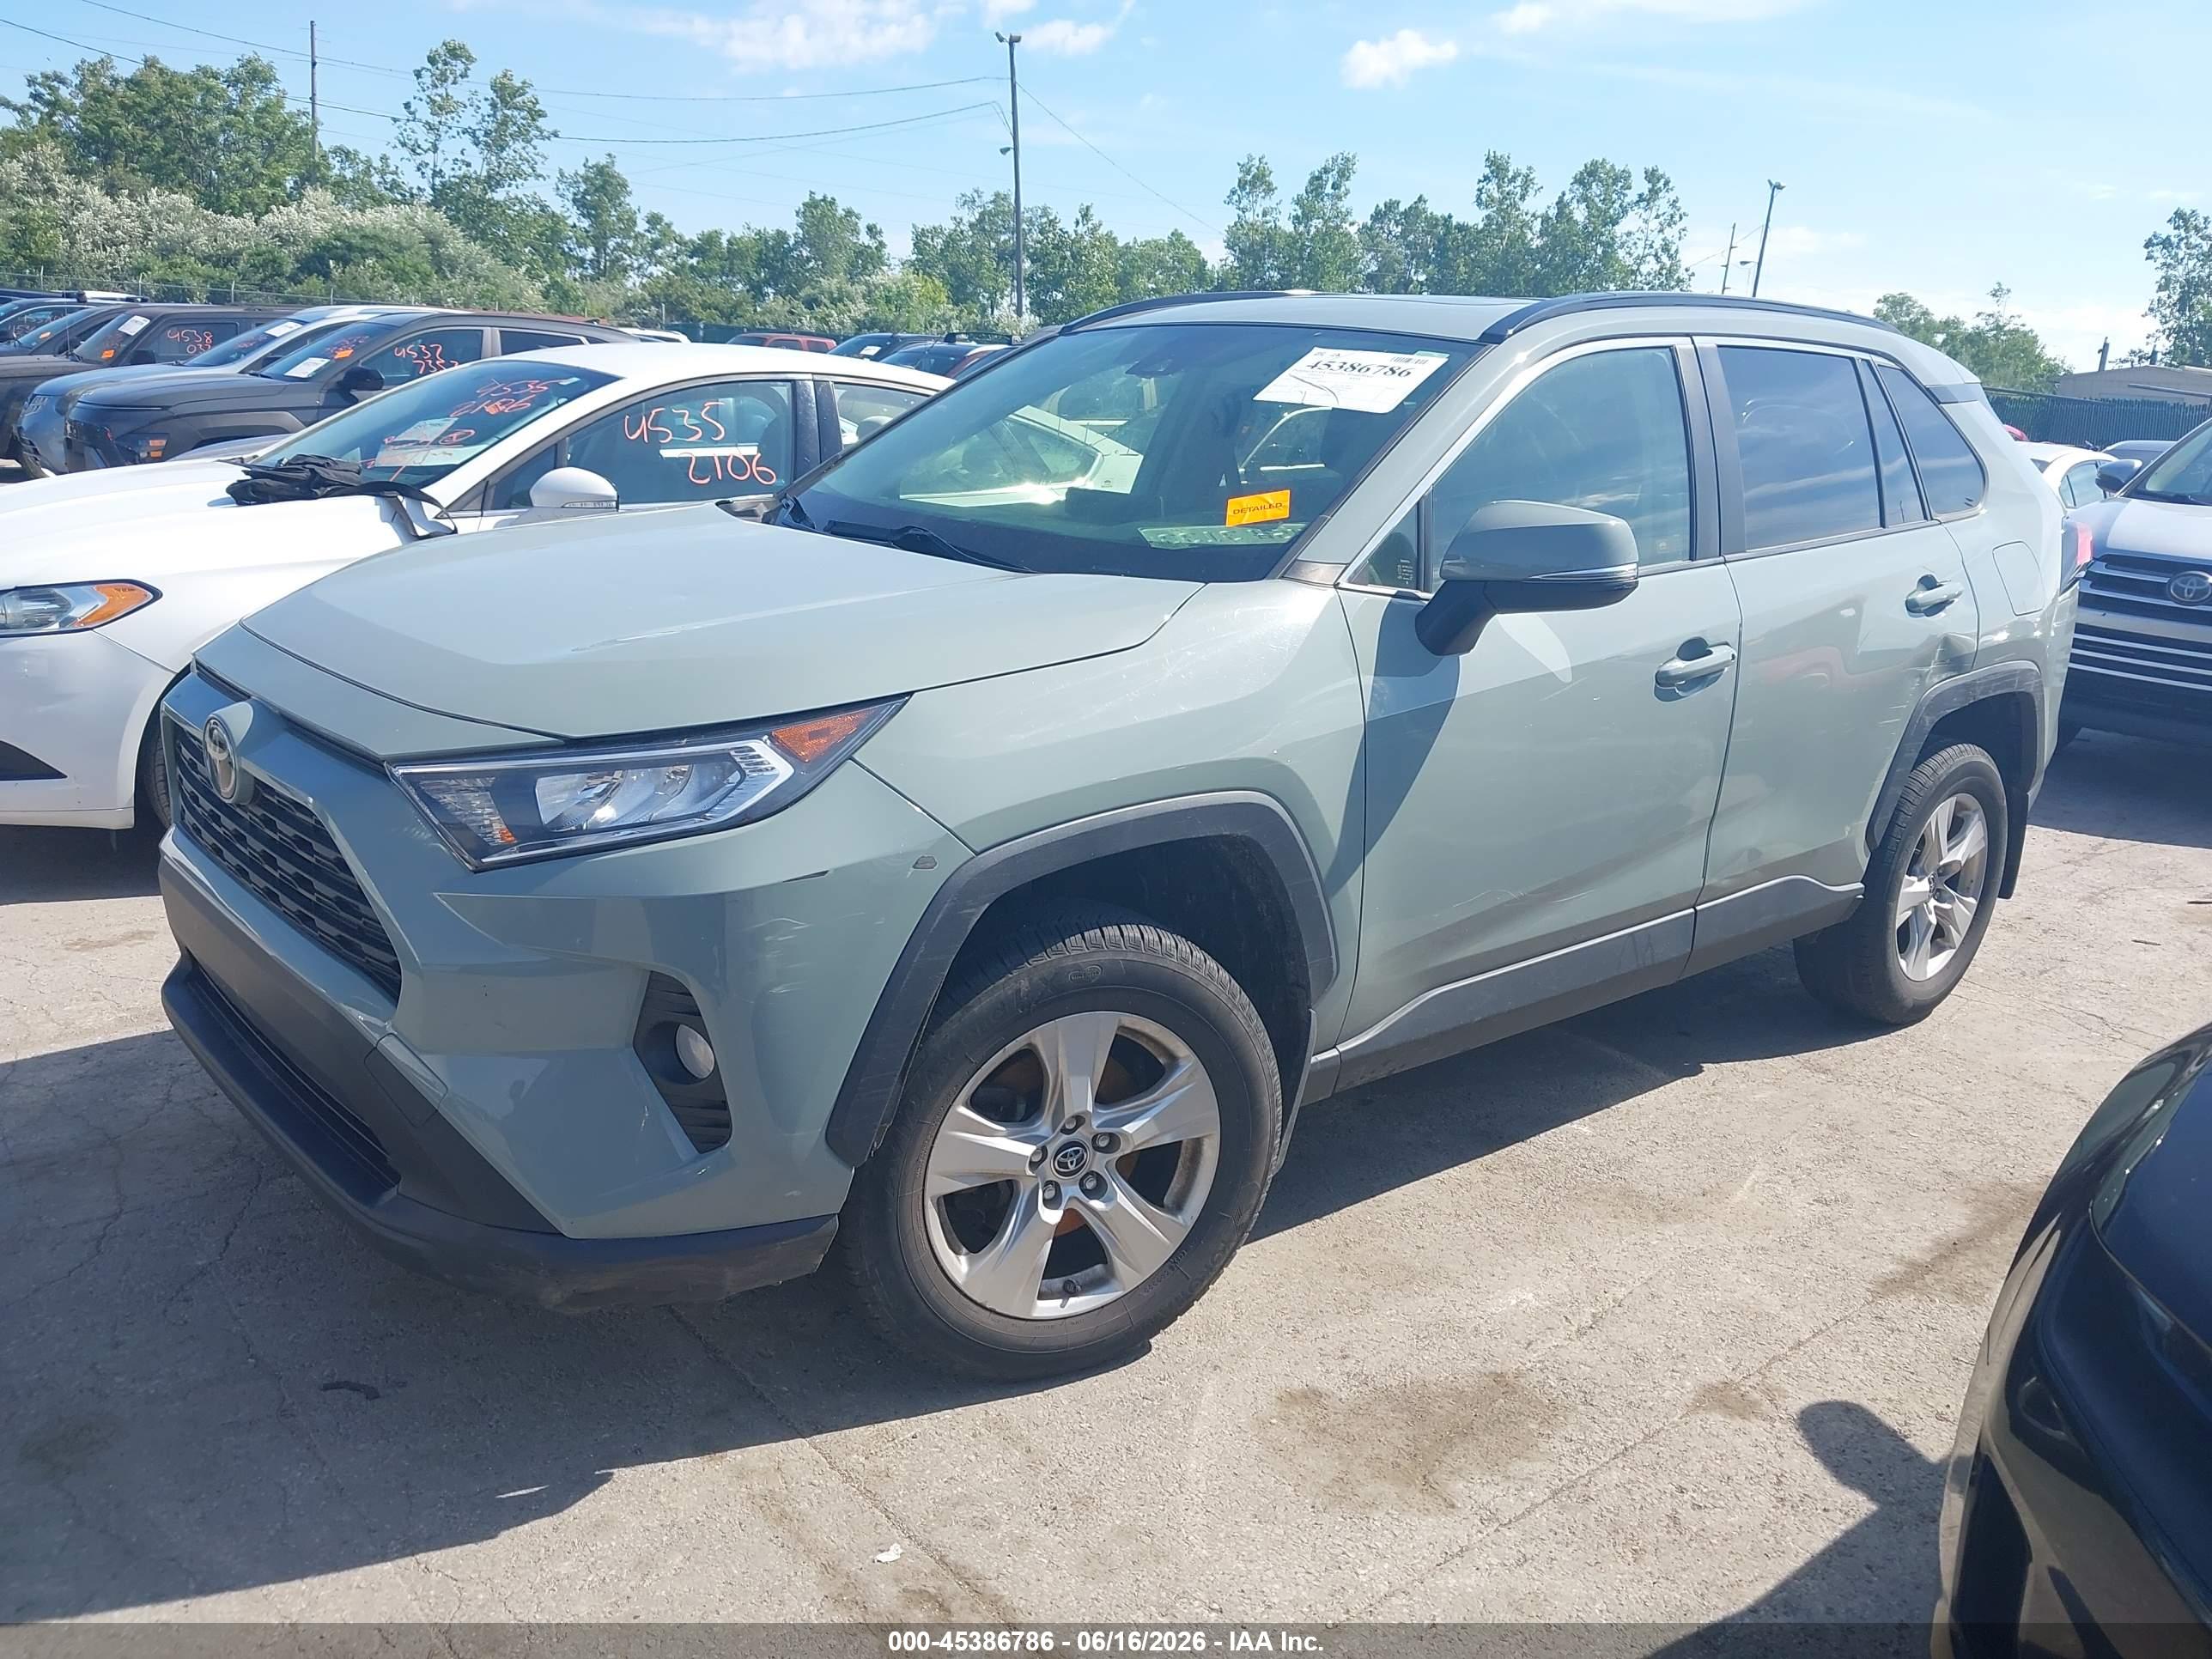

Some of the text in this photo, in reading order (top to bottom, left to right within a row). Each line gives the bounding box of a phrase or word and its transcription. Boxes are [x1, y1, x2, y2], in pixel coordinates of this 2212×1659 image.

[1306, 359, 1417, 378] 45386786
[624, 401, 726, 444] 4535
[677, 451, 777, 486] 2106
[1232, 502, 1284, 515] DETAILED
